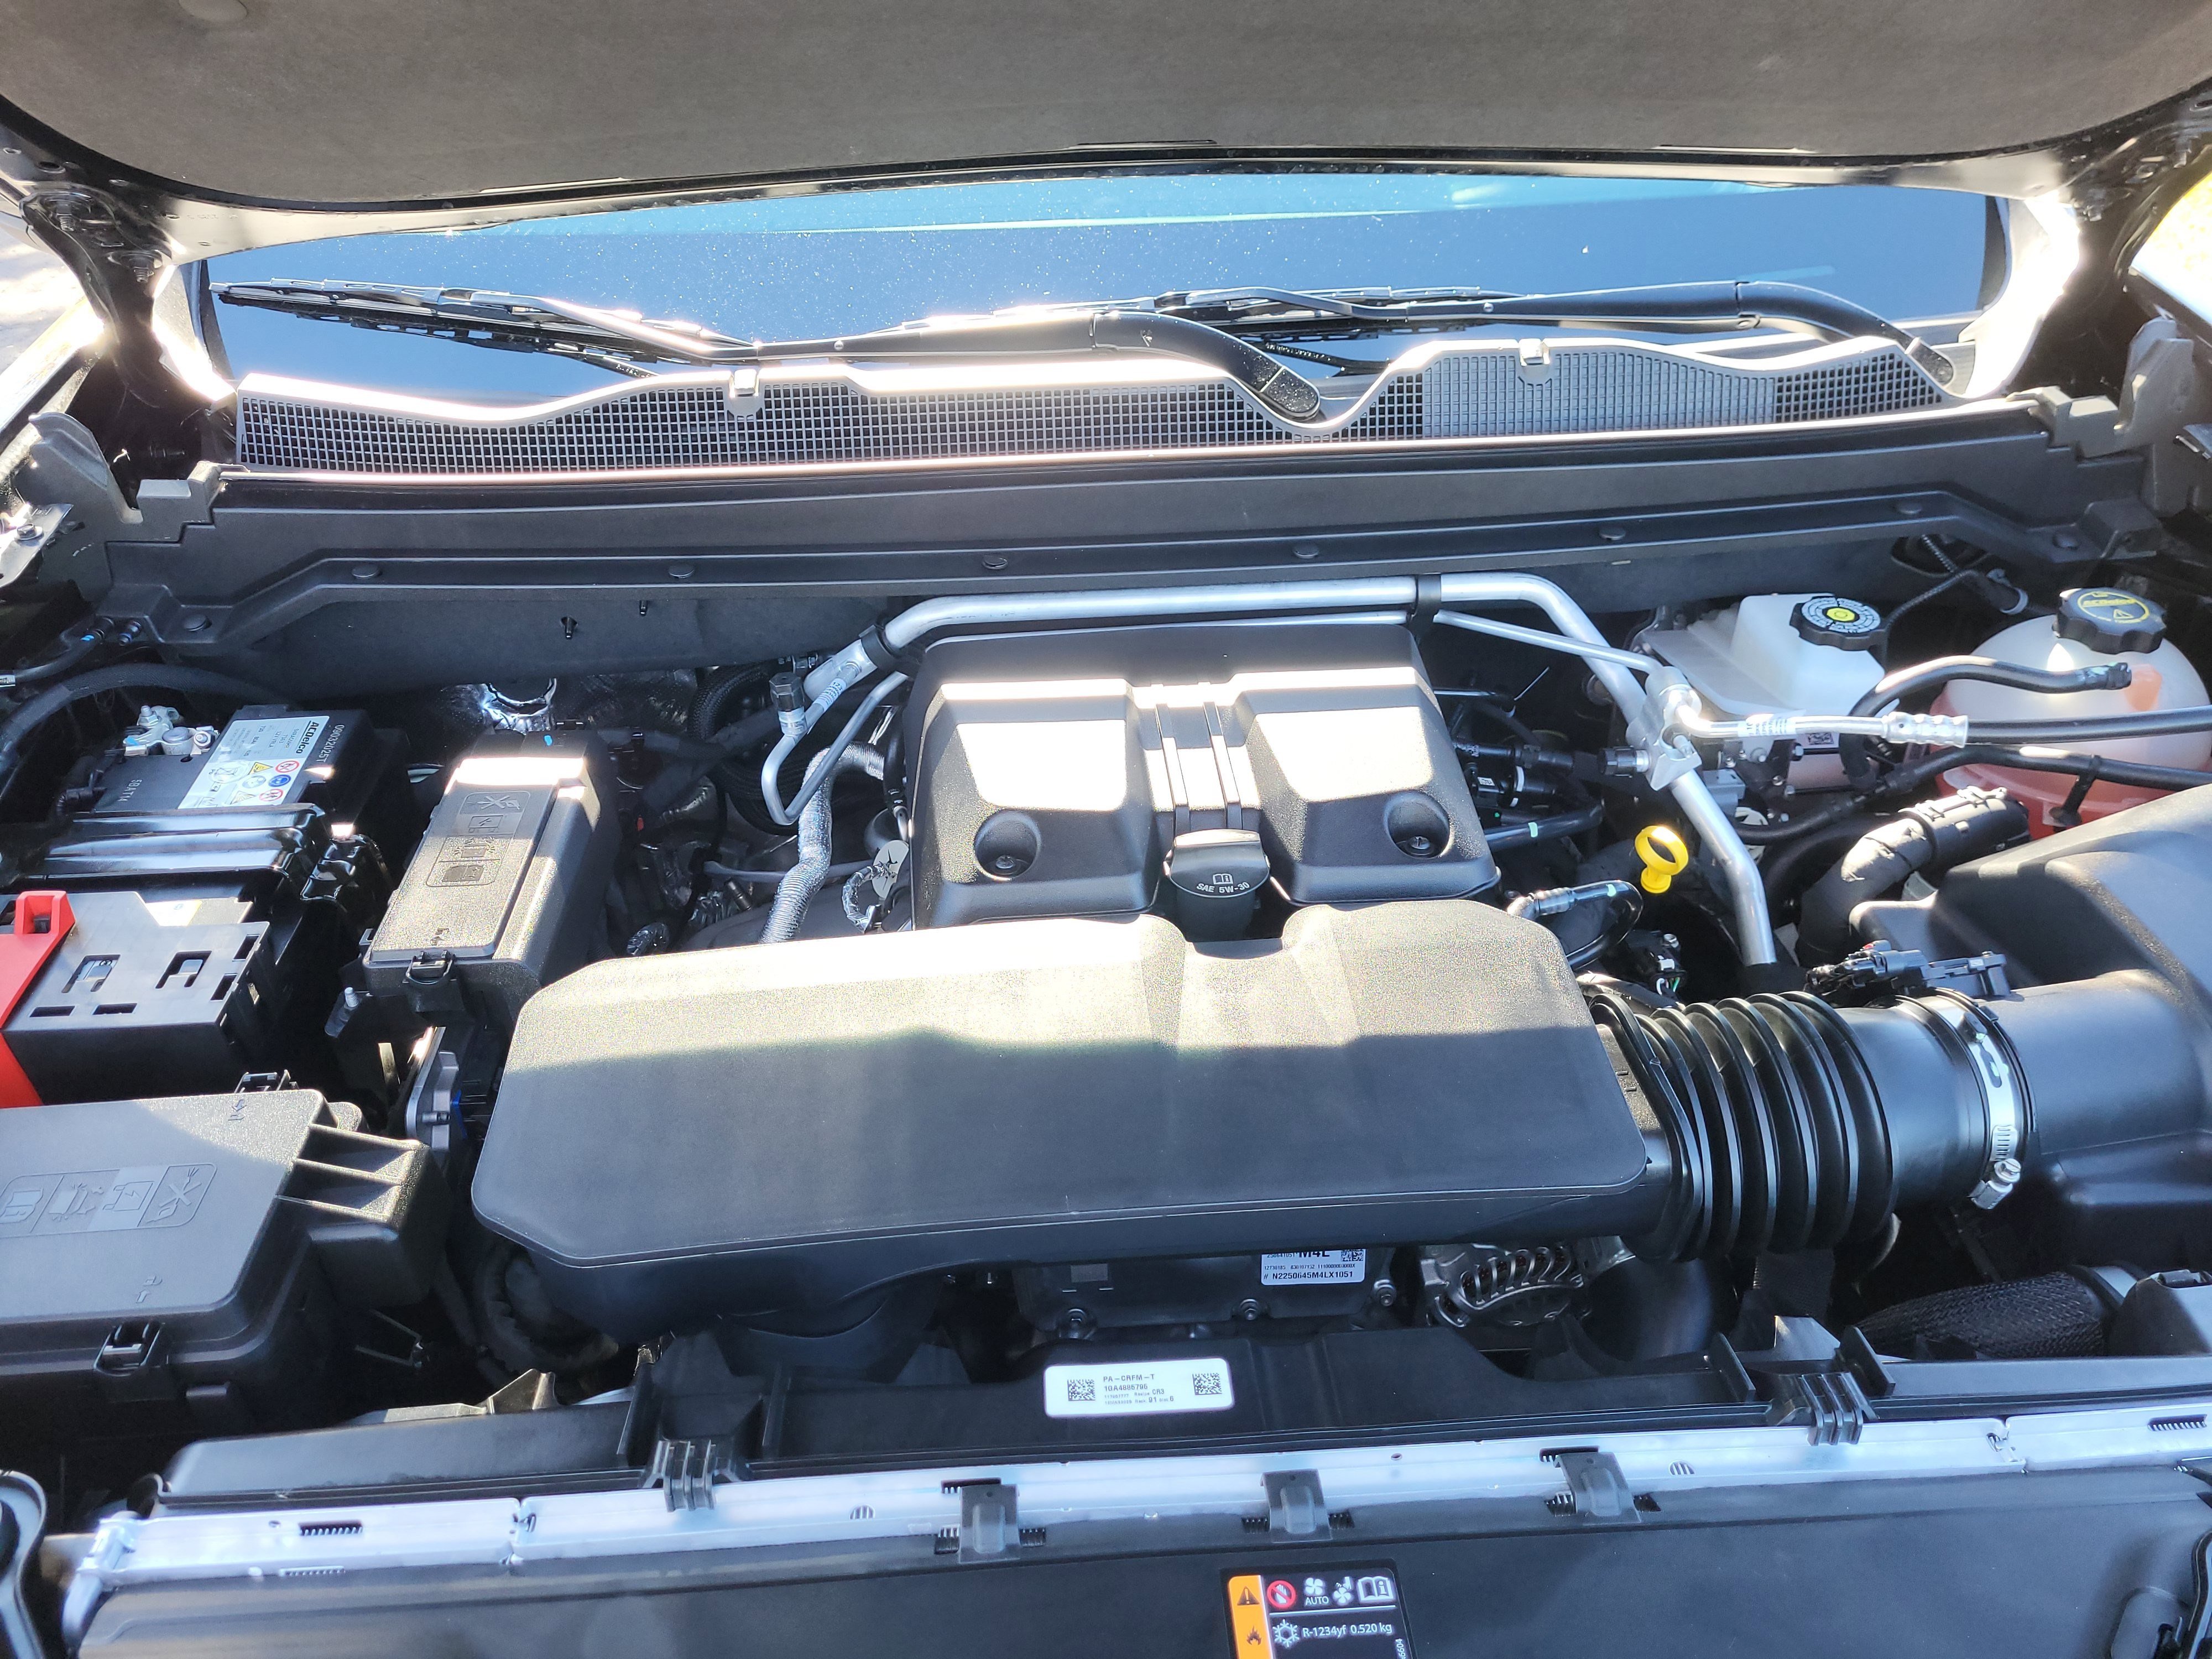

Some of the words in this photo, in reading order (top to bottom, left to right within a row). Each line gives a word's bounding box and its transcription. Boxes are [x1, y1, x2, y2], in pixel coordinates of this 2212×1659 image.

[296, 722, 320, 754] ACDelco
[316, 724, 345, 763] 09032025T
[117, 779, 142, 801] 5BAT14
[1196, 883, 1215, 893] SAE
[1219, 881, 1250, 893] 5W-30
[1306, 1596, 1329, 1605] AUTO
[1302, 1624, 1347, 1638] R-1234yf
[1350, 1623, 1378, 1634] 0.520
[1379, 1622, 1392, 1634] kg
